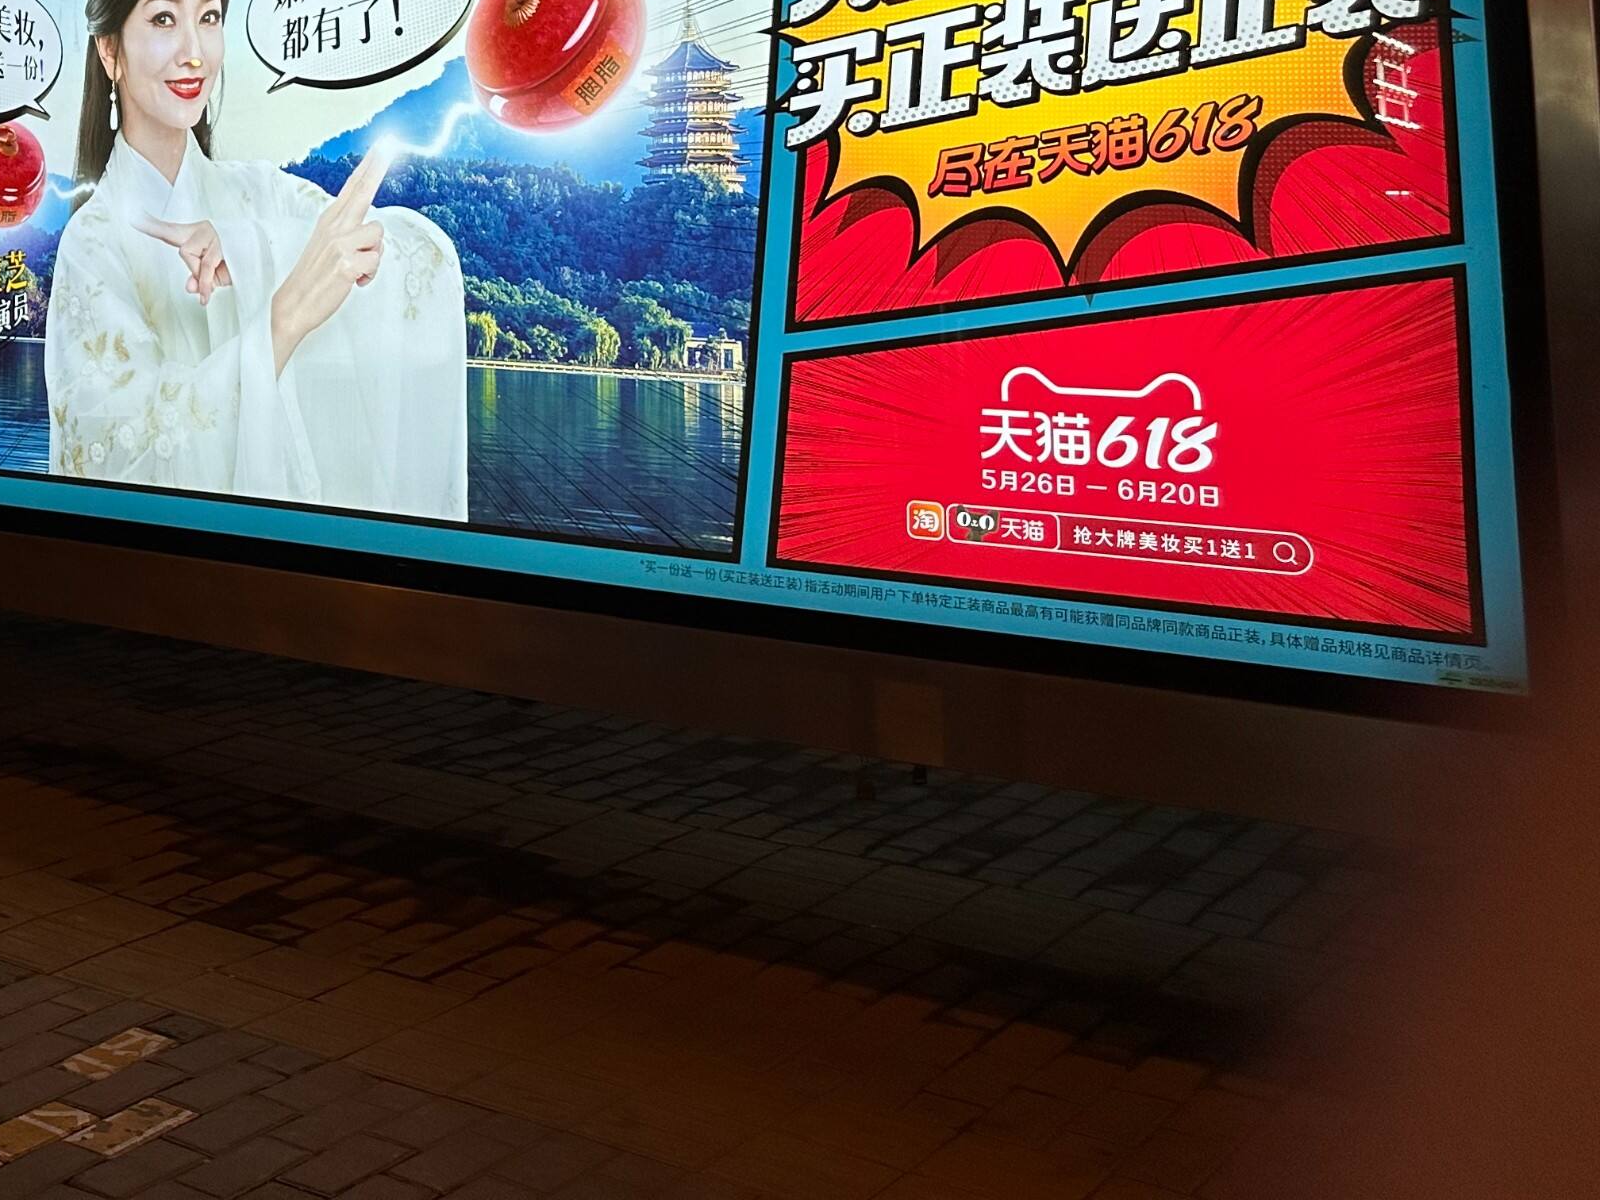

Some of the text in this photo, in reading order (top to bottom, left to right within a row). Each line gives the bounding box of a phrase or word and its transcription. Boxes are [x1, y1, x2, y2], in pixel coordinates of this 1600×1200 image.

[573, 54, 621, 106] 胭脂
[929, 94, 1263, 198] 尽在天猫618
[979, 407, 1218, 473] 天猫618
[912, 508, 1257, 561] 淘 天猫 抢大牌美妆买1送1
